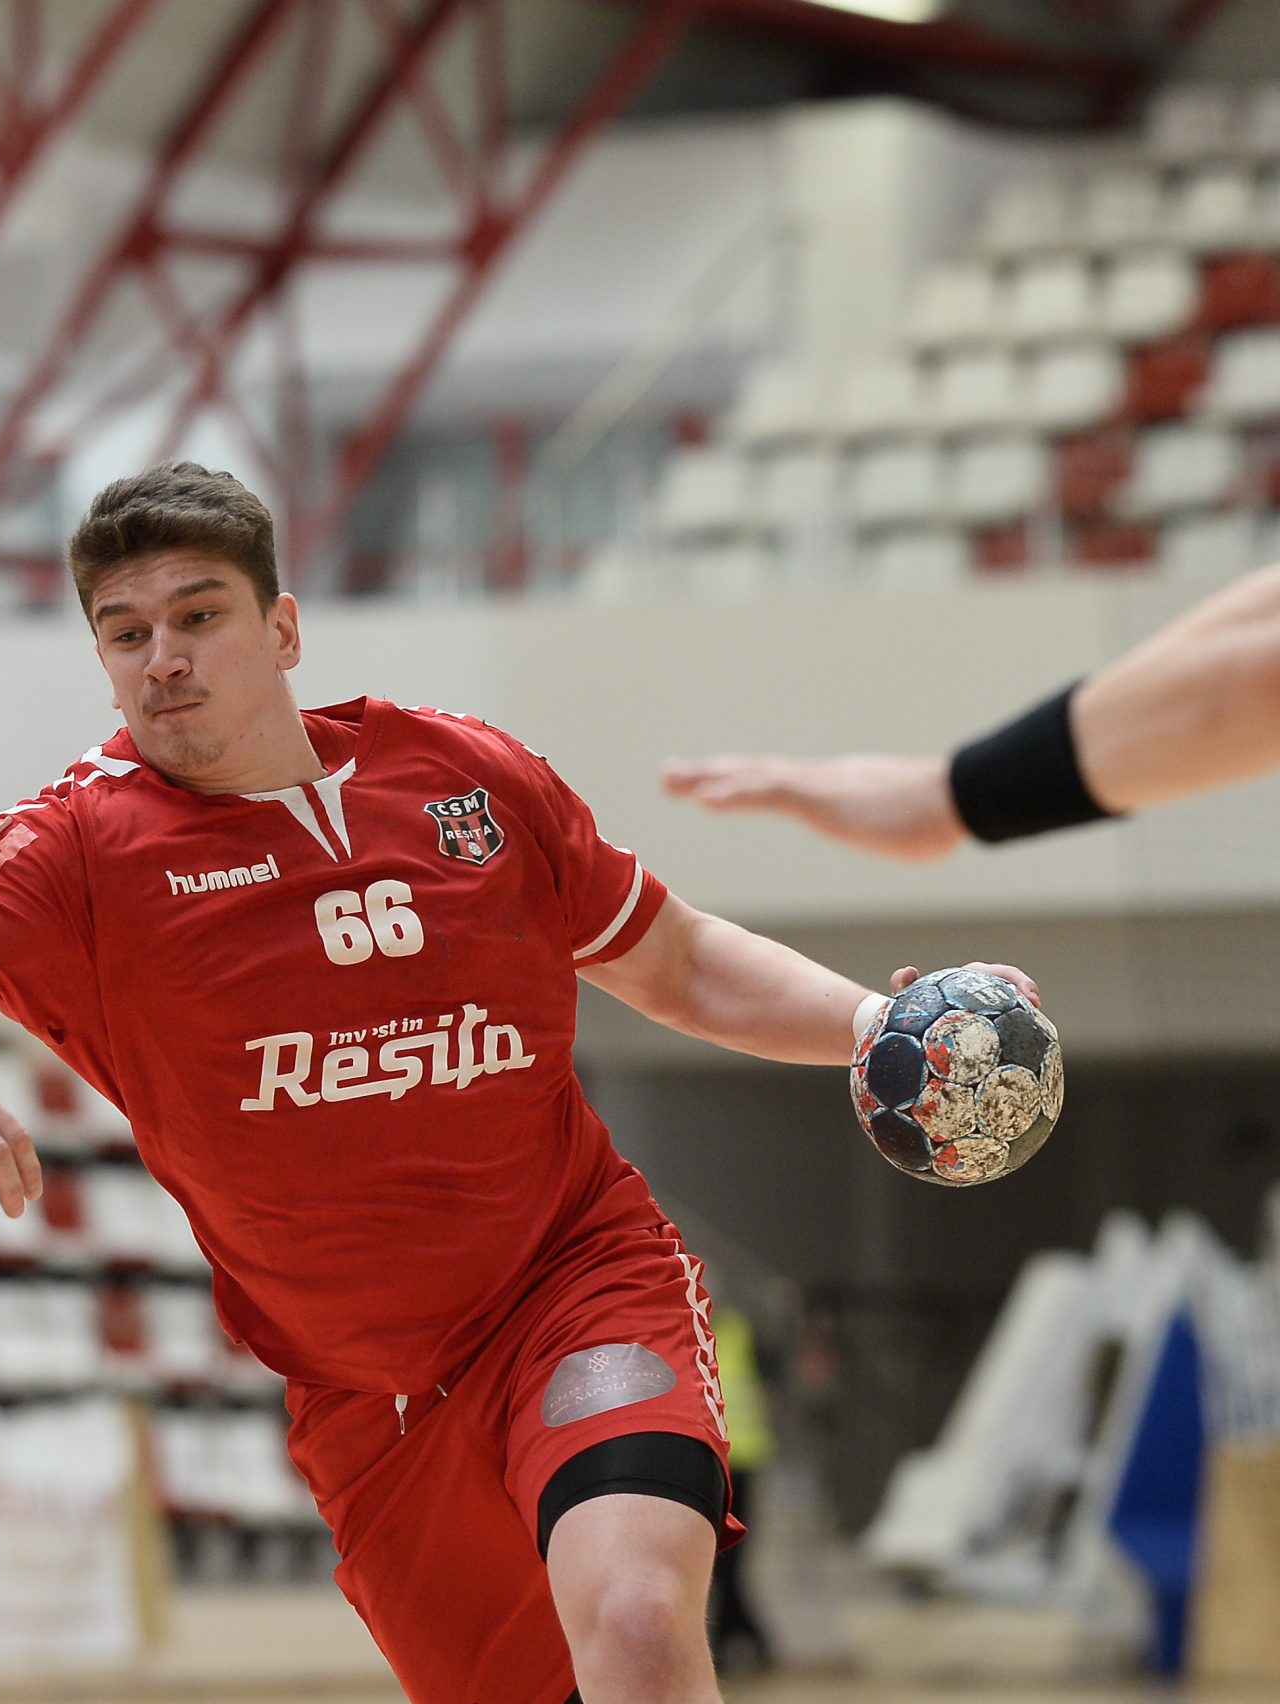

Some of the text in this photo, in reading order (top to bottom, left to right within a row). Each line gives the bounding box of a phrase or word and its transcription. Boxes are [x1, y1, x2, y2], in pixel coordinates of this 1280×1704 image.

[436, 795, 480, 816] CSM
[165, 854, 280, 896] hummel
[314, 879, 425, 965] 66
[401, 1017, 423, 1033] in
[575, 1381, 628, 1403] NAPOLI
